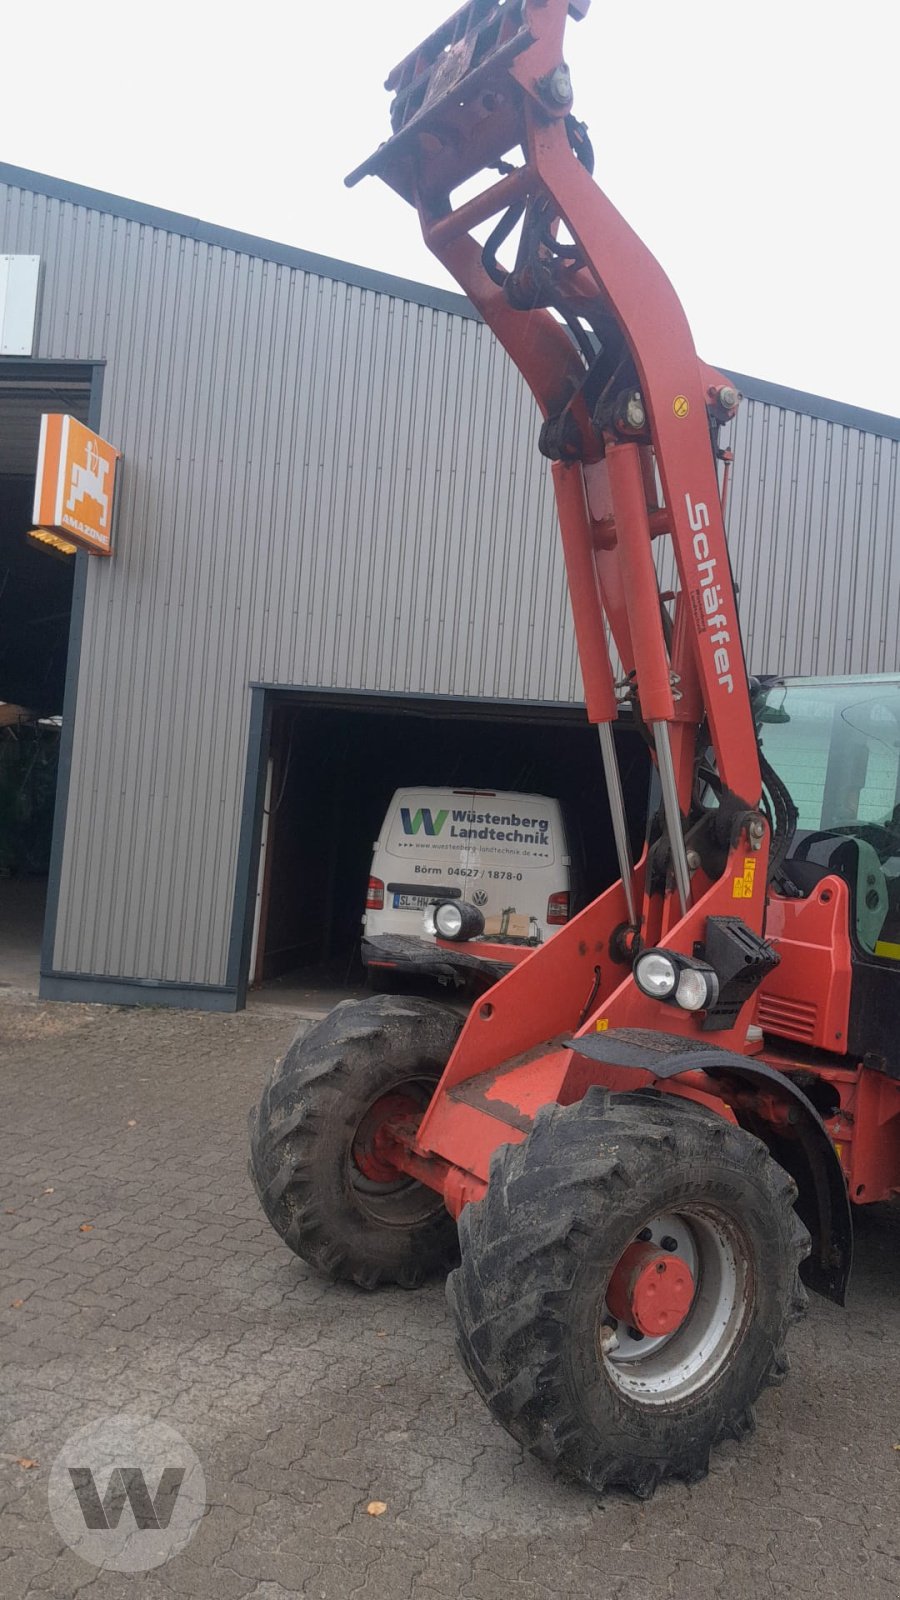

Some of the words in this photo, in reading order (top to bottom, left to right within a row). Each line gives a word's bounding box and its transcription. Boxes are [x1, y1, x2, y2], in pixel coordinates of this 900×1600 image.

[685, 493, 734, 694] Schäffer
[452, 810, 549, 832] Wüstenberg
[450, 826, 549, 846] Landtechnik
[414, 865, 442, 875] Börm
